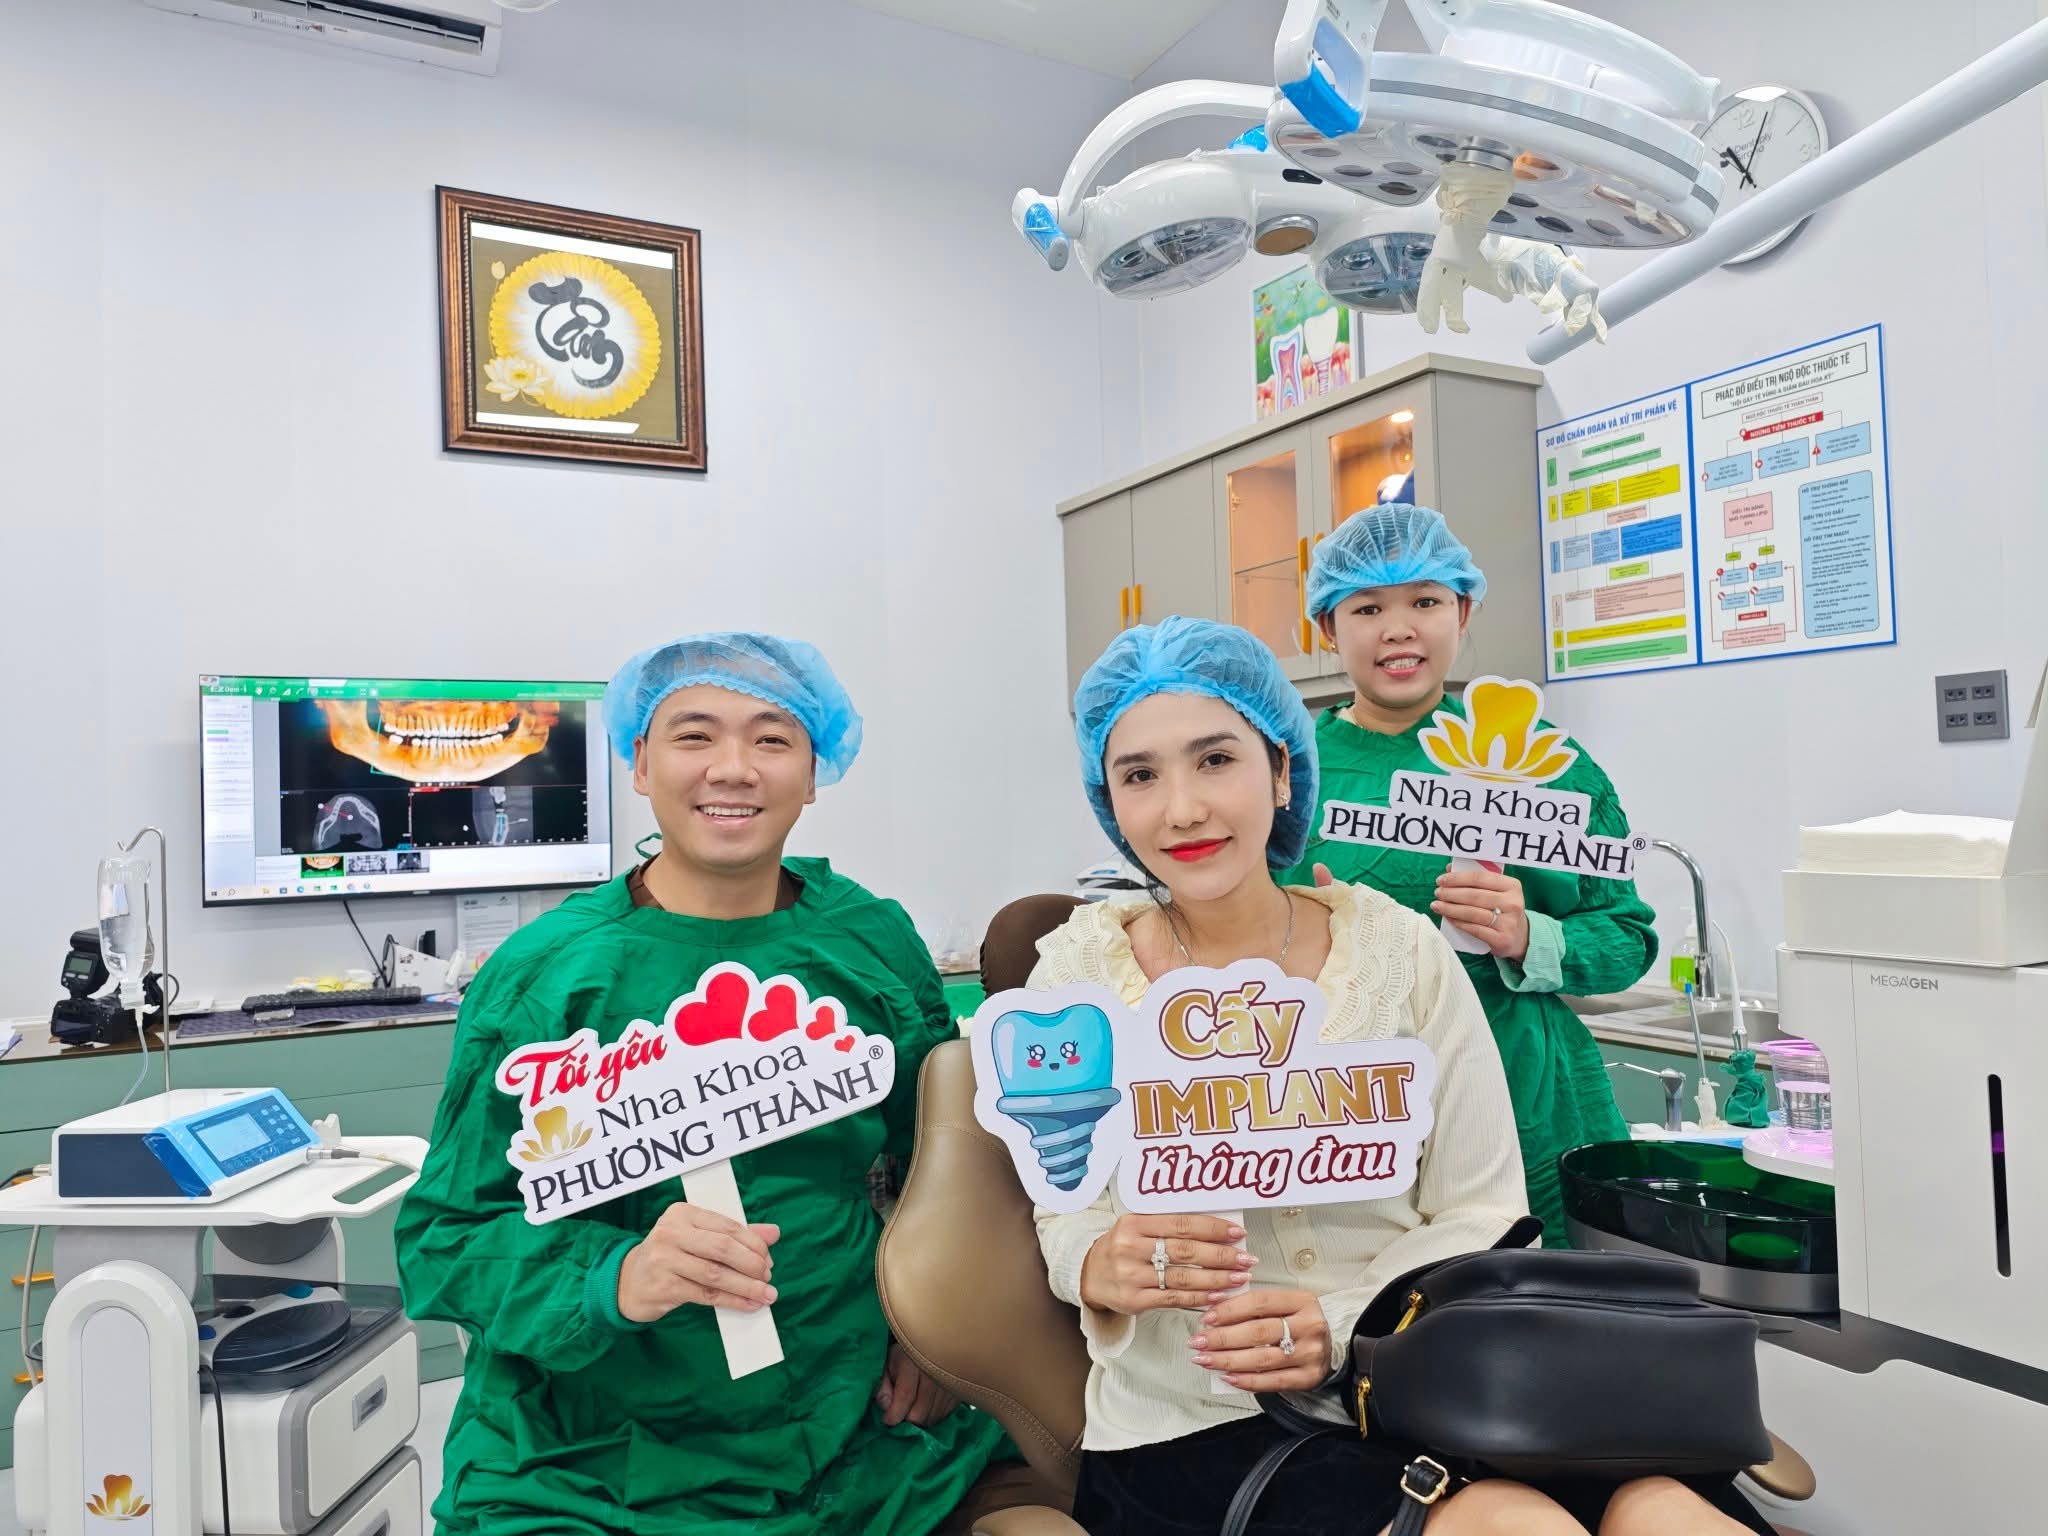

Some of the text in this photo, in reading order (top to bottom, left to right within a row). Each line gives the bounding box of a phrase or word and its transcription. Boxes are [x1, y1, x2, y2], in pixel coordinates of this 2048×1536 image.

[1734, 132, 1772, 153] Dentply
[1327, 807, 1482, 853] PHƯƠNG
[1398, 777, 1581, 826] Nha Khoa
[1159, 982, 1305, 1067] Cấy
[506, 1030, 667, 1107] Tôi yêu
[596, 1045, 807, 1138] Nha Khoa
[1131, 1062, 1414, 1139] IMPLANT
[530, 1121, 718, 1213] PHƯƠNG
[1138, 1136, 1396, 1197] Không đau
